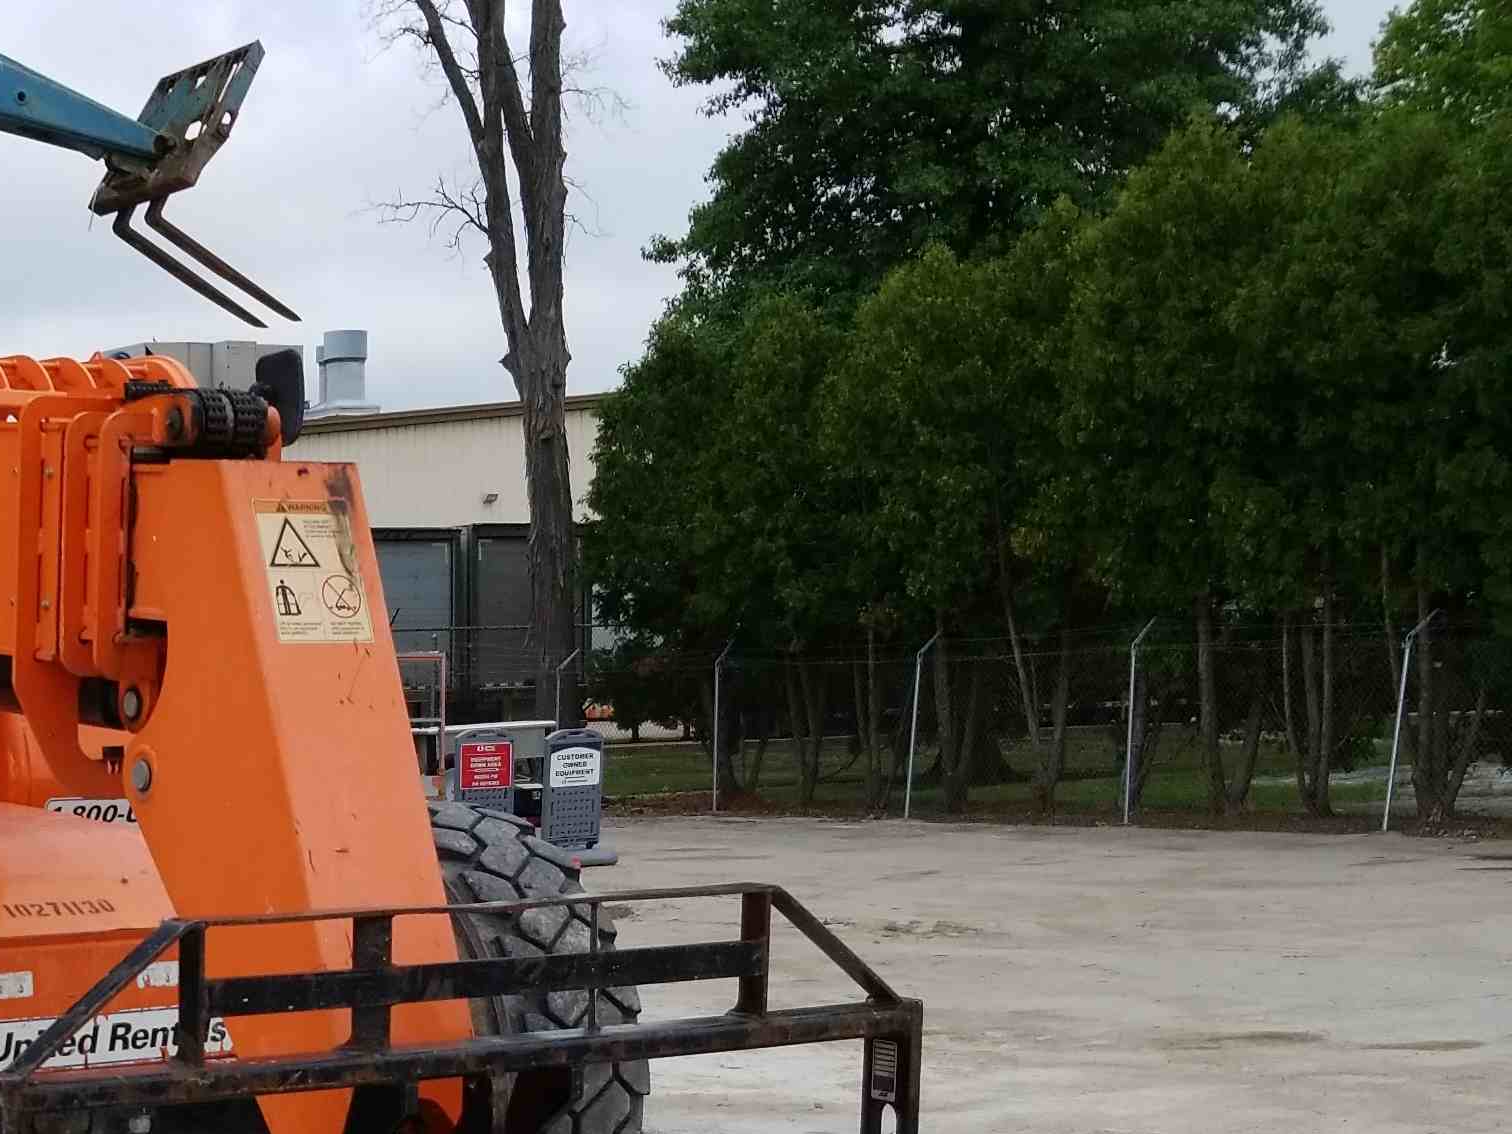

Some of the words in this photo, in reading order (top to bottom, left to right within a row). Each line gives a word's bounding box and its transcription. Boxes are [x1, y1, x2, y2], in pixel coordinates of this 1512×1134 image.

[288, 502, 328, 513] WARNING
[556, 752, 594, 761] CUSTOMER
[555, 768, 594, 777] EQUIPMENT
[108, 1021, 227, 1052] Rents
